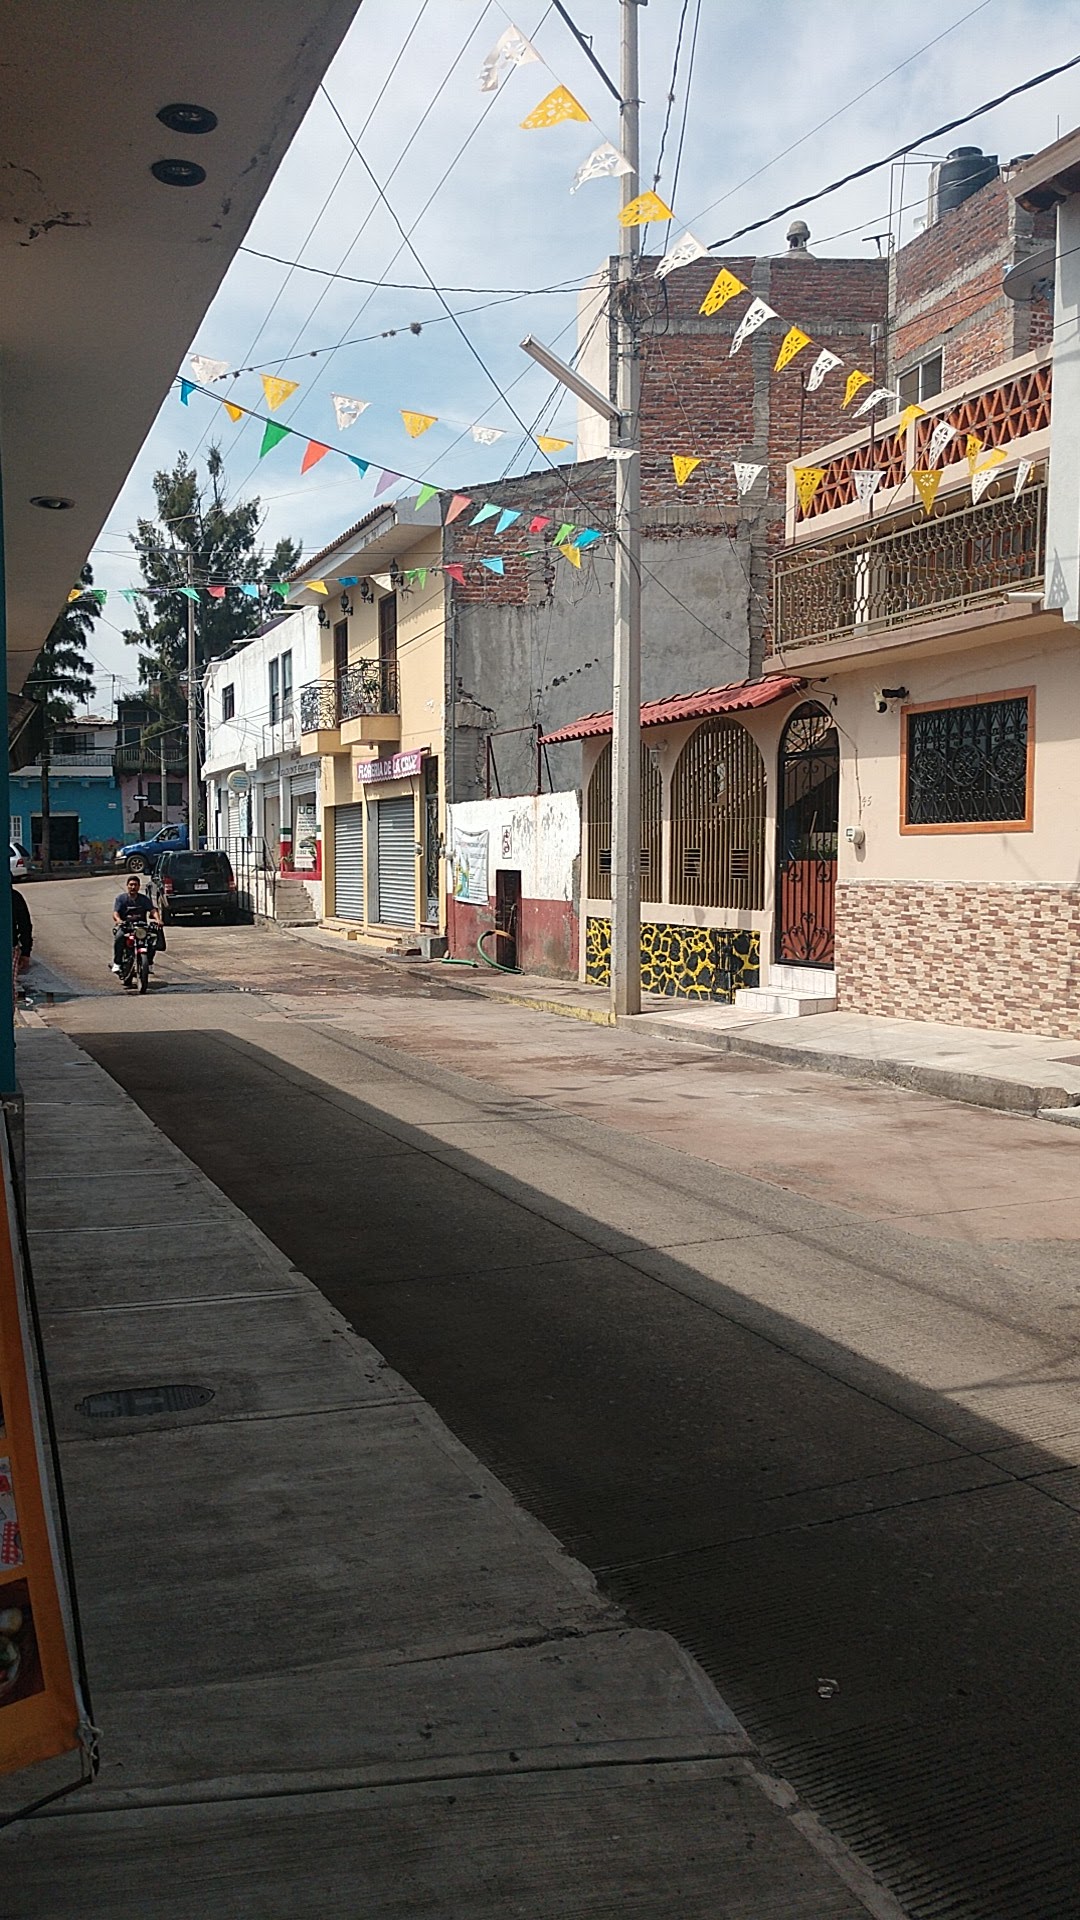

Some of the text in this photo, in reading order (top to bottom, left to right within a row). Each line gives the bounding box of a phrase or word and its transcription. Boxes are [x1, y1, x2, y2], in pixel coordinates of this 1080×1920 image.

[384, 760, 392, 775] DE
[392, 758, 401, 774] LA
[401, 754, 418, 771] CRUZ
